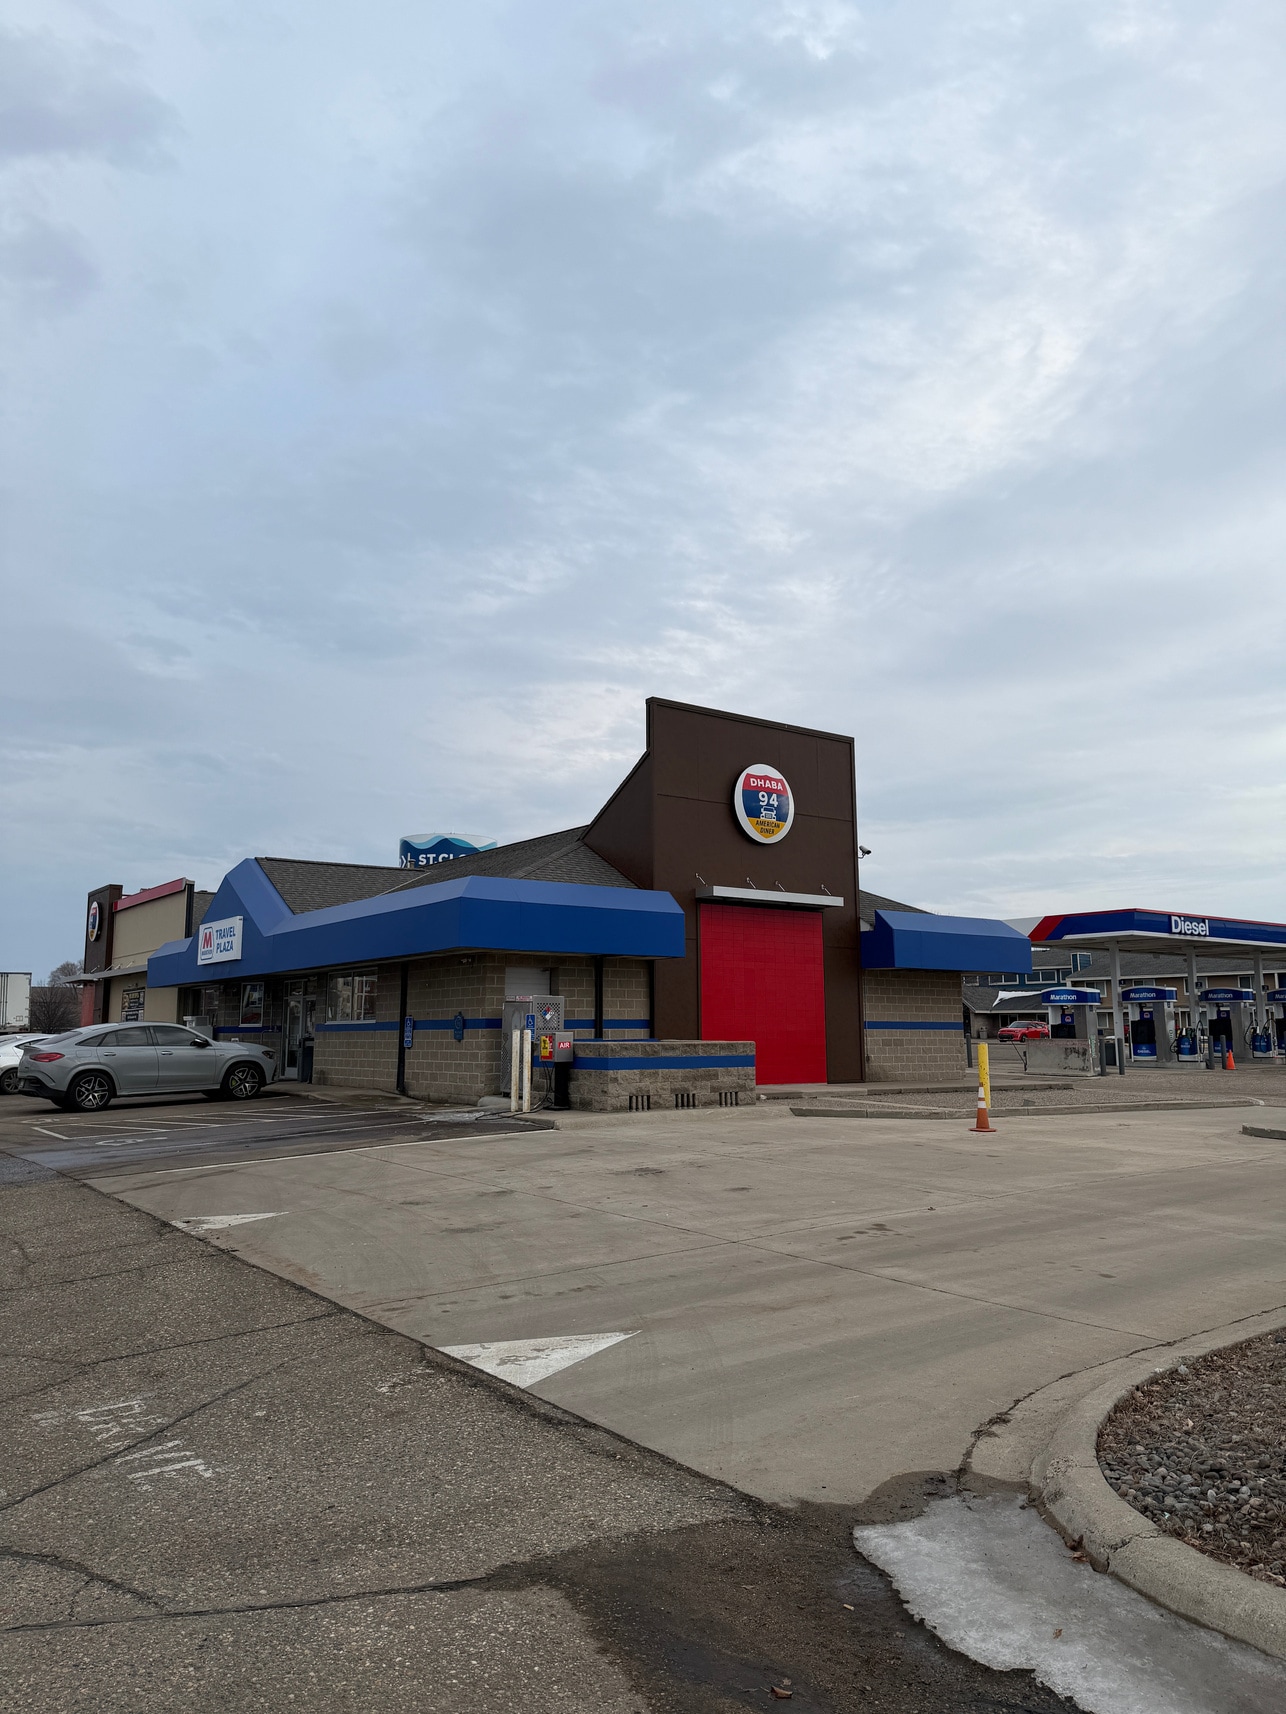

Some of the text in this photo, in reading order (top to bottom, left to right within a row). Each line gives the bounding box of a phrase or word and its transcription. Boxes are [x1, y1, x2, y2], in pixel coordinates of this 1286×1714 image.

[749, 778, 783, 791] DHABA
[758, 791, 778, 808] 94
[755, 820, 781, 829] AMERICAN
[759, 827, 775, 835] DINER
[1171, 915, 1209, 936] Diesel
[215, 926, 236, 940] TRAVEL
[215, 940, 234, 954] PLAZA
[1050, 993, 1077, 1001] Marathon
[1130, 991, 1156, 999] Marathon
